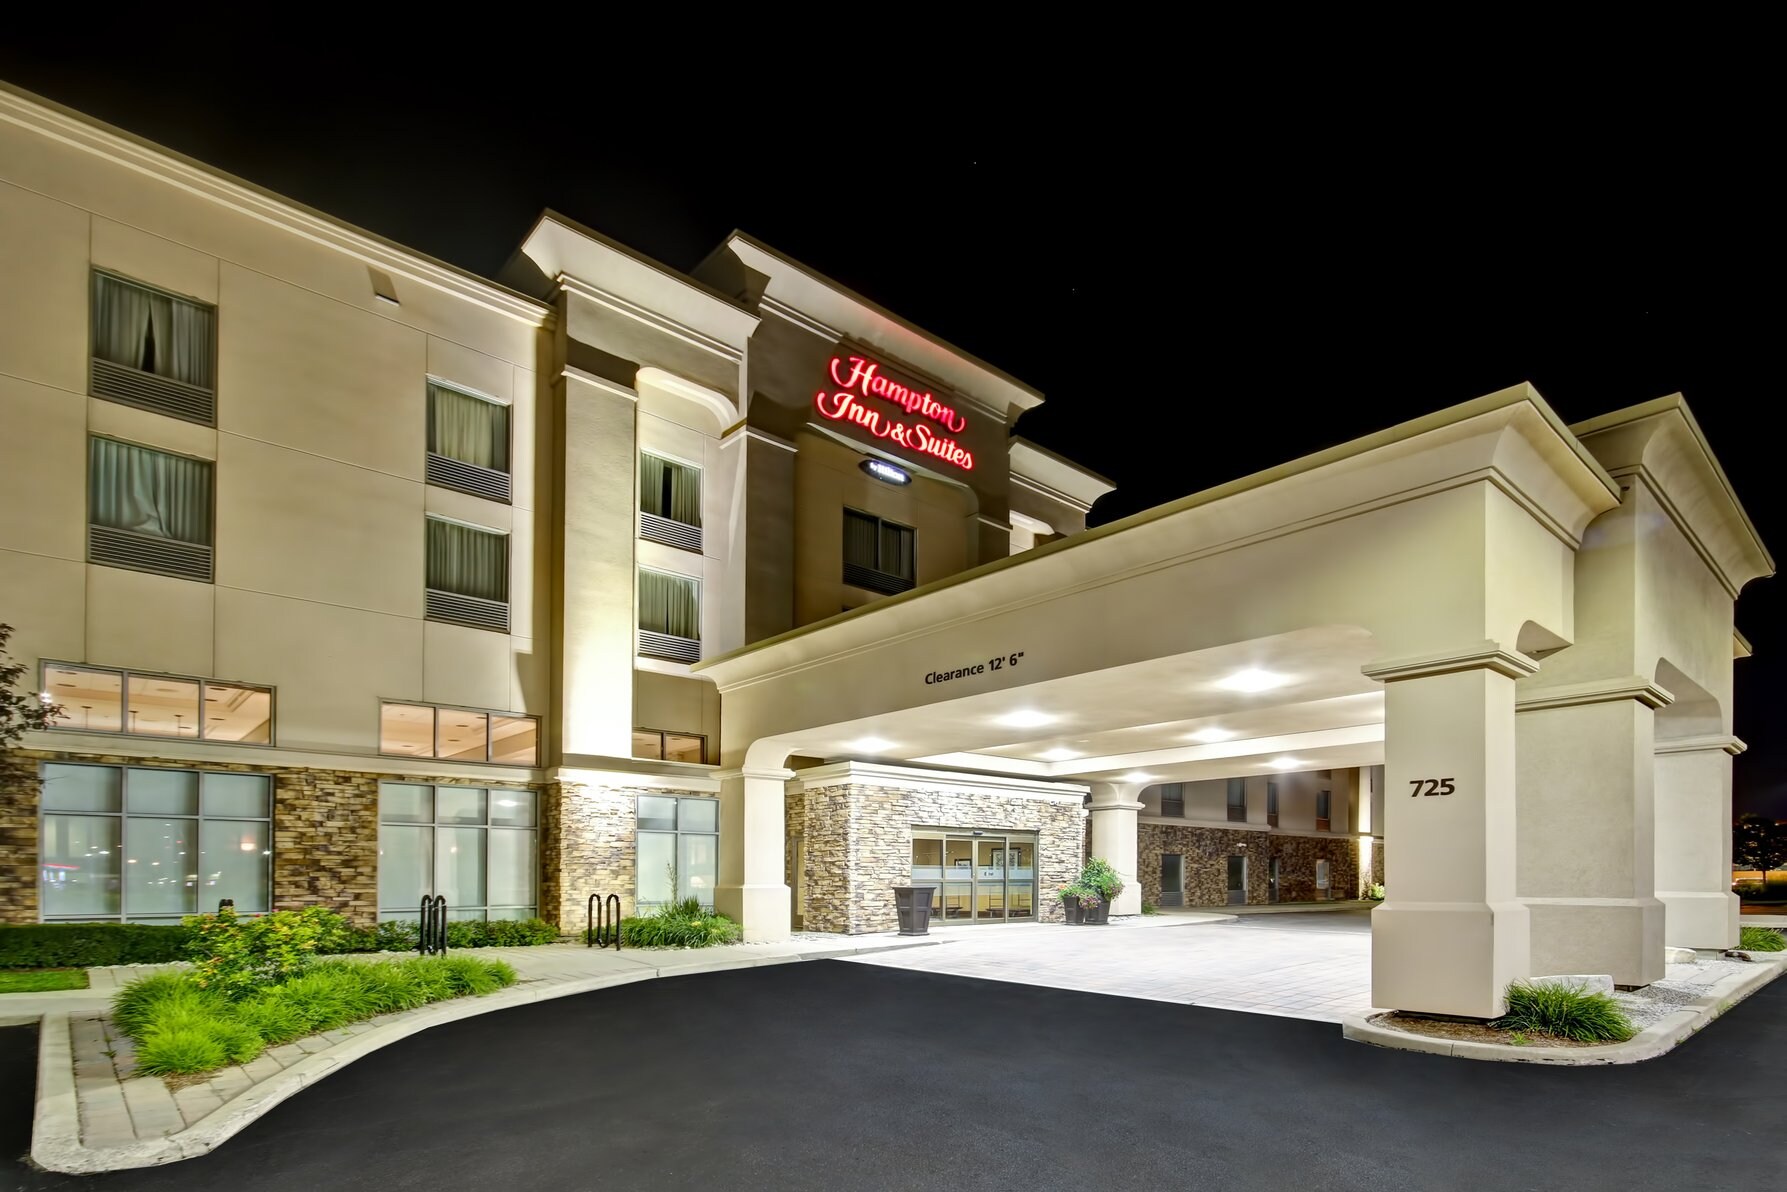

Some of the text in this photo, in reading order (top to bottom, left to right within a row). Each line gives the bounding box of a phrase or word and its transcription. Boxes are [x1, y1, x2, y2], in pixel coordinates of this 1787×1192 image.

[830, 355, 966, 433] Hampton
[816, 391, 892, 438] Inn
[906, 423, 974, 470] Suites
[925, 663, 985, 685] Clearance
[988, 656, 1006, 671] 12'
[1409, 777, 1456, 798] 725
